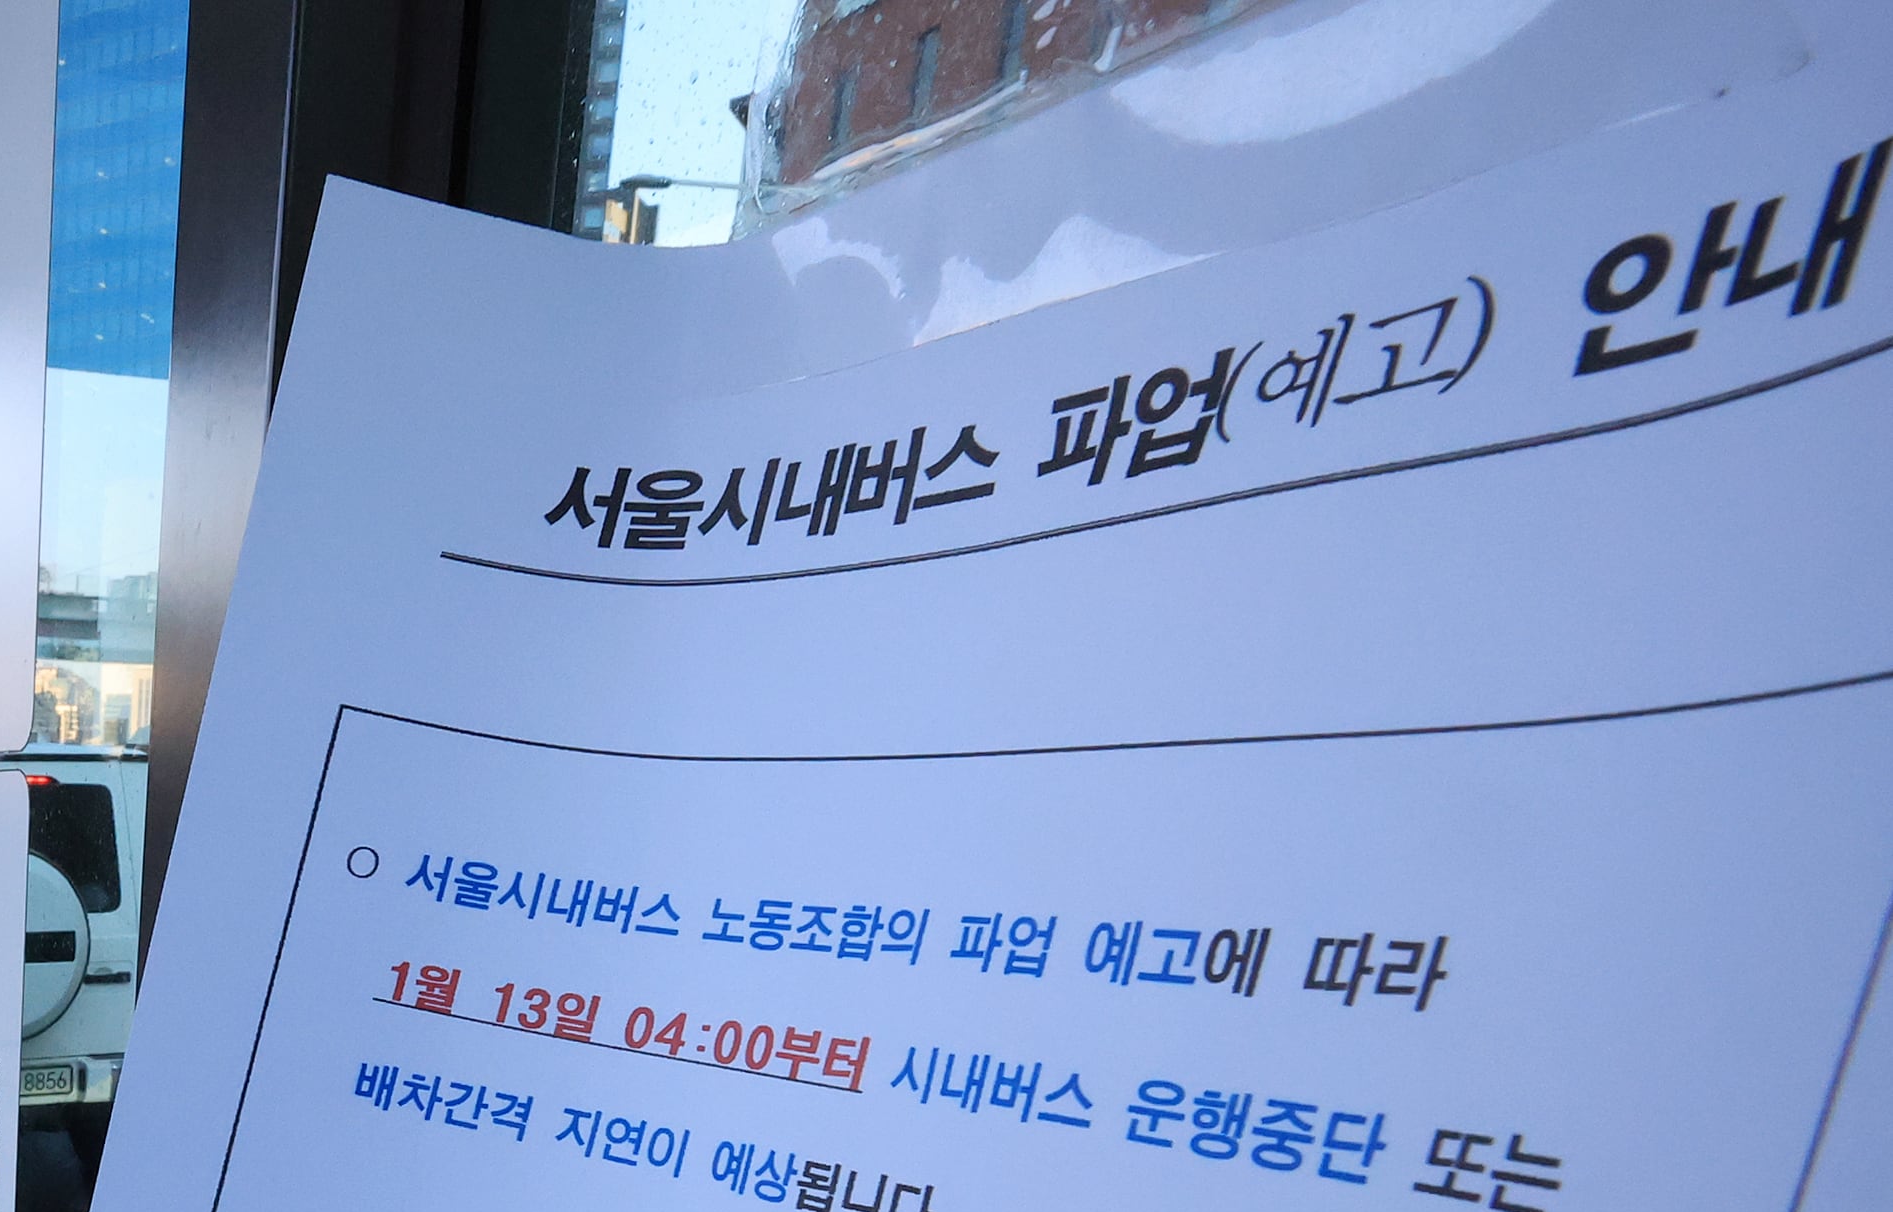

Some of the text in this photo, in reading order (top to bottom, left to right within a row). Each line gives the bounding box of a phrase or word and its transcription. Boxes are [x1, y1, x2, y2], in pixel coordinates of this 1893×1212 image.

[543, 135, 1893, 552] 서울시내버스 파업(예고) 안내
[405, 853, 1448, 1012] 서울시내버스 노동조합의 파업 예고에 따라
[24, 1071, 66, 1091] 8856
[355, 1062, 534, 1141] 배차간격
[556, 1106, 690, 1177] 지연이
[389, 961, 462, 1014] 1월
[493, 981, 601, 1042] 13일
[624, 1006, 871, 1091] 04:00부터
[891, 1046, 1094, 1129] 시내버스
[1126, 1079, 1386, 1184] 운행중단
